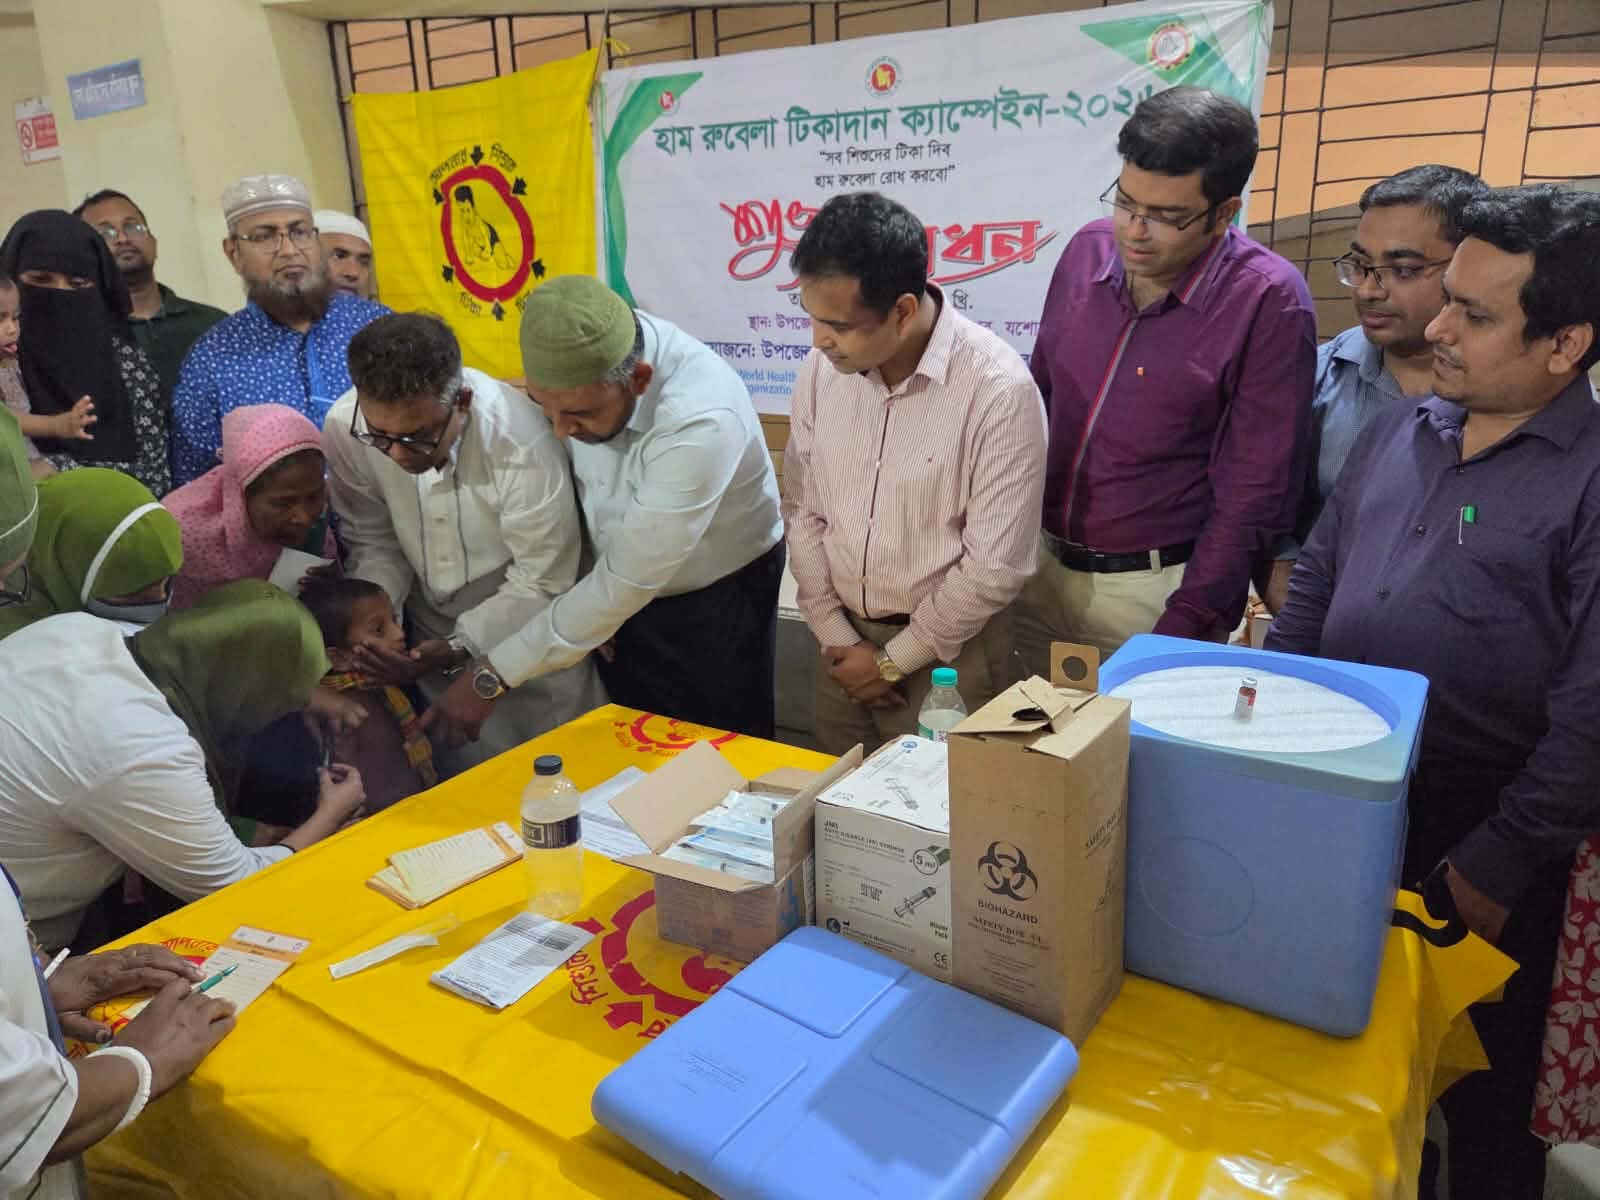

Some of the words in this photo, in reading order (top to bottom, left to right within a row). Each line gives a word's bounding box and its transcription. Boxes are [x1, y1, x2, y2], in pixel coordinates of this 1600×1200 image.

[652, 124, 695, 155] হাম
[700, 114, 778, 152] রুবেলা
[784, 105, 891, 147] টিকাদান
[895, 141, 924, 161] টিকা
[977, 898, 1039, 925] BIOHAZARD
